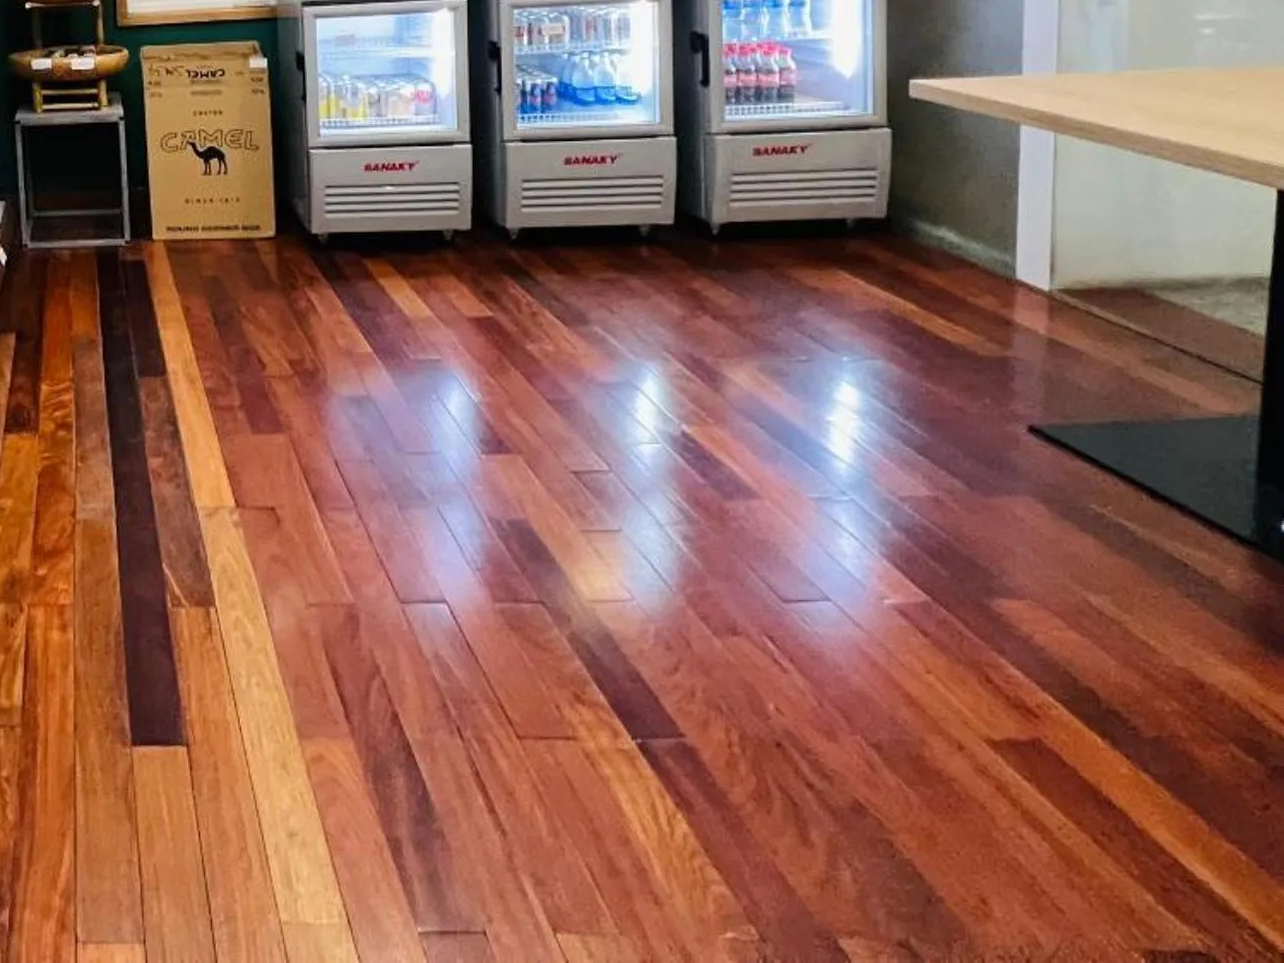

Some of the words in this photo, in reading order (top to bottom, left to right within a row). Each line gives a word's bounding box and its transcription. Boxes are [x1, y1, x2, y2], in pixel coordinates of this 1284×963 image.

[160, 128, 260, 154] CAMEL
[752, 144, 813, 156] SANAKY
[564, 154, 621, 165] SANAKY
[364, 161, 419, 171] SANAKY
